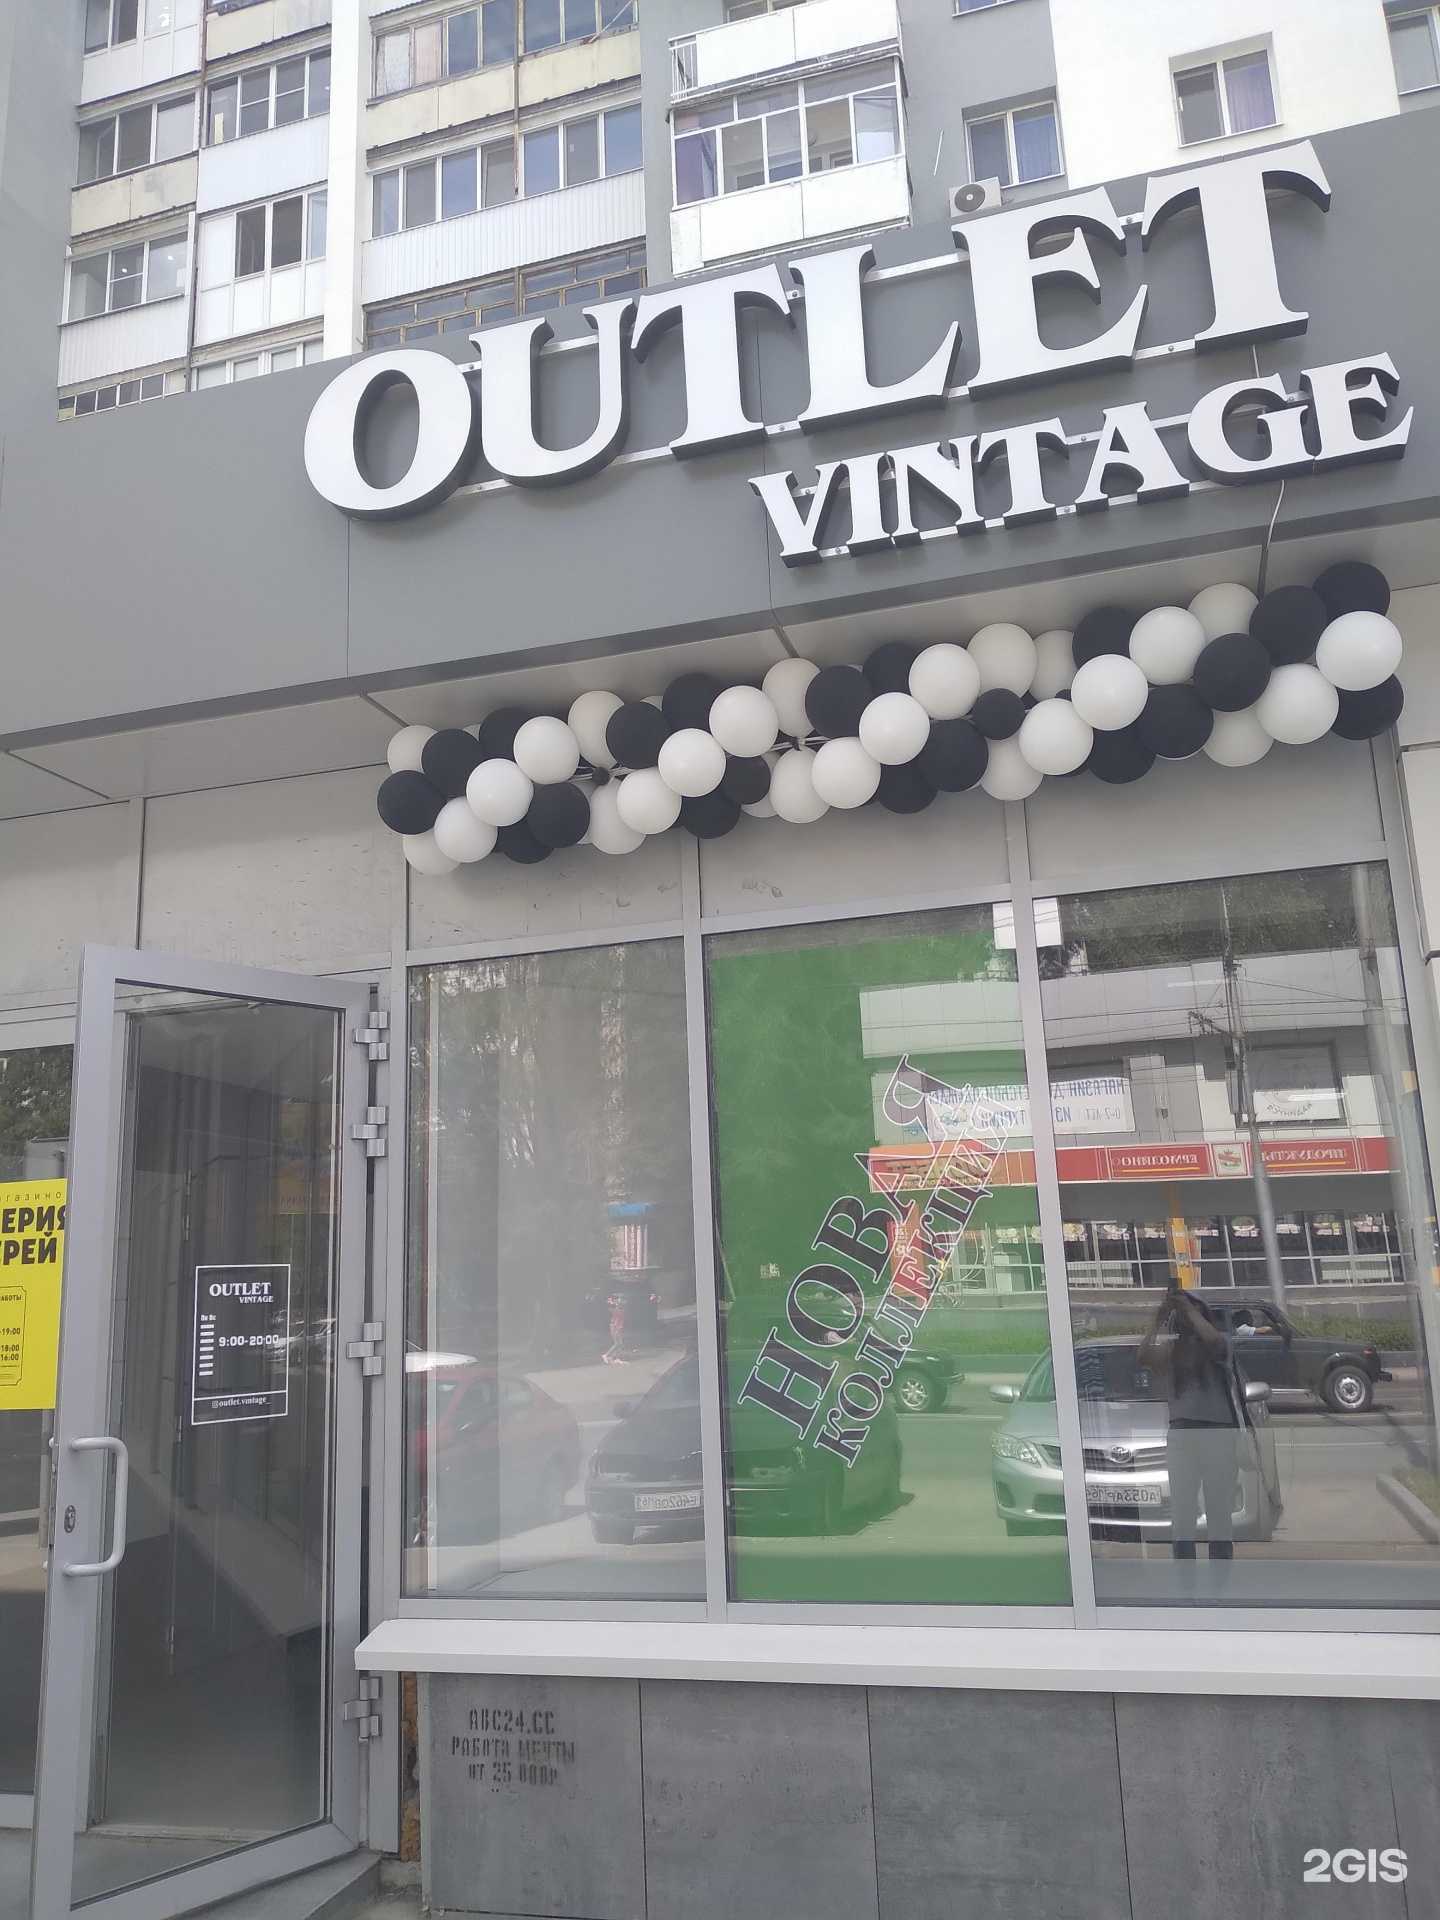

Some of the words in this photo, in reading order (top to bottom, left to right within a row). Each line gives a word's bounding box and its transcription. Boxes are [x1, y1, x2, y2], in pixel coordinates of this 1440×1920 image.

[303, 140, 1332, 516] OUTLET
[749, 352, 1414, 566] VINTAGE
[0, 1231, 57, 1265] РЕЙ
[209, 1282, 272, 1297] OUTLET
[239, 1295, 274, 1304] VINTAGE
[737, 1053, 971, 1440] НОВАЯ
